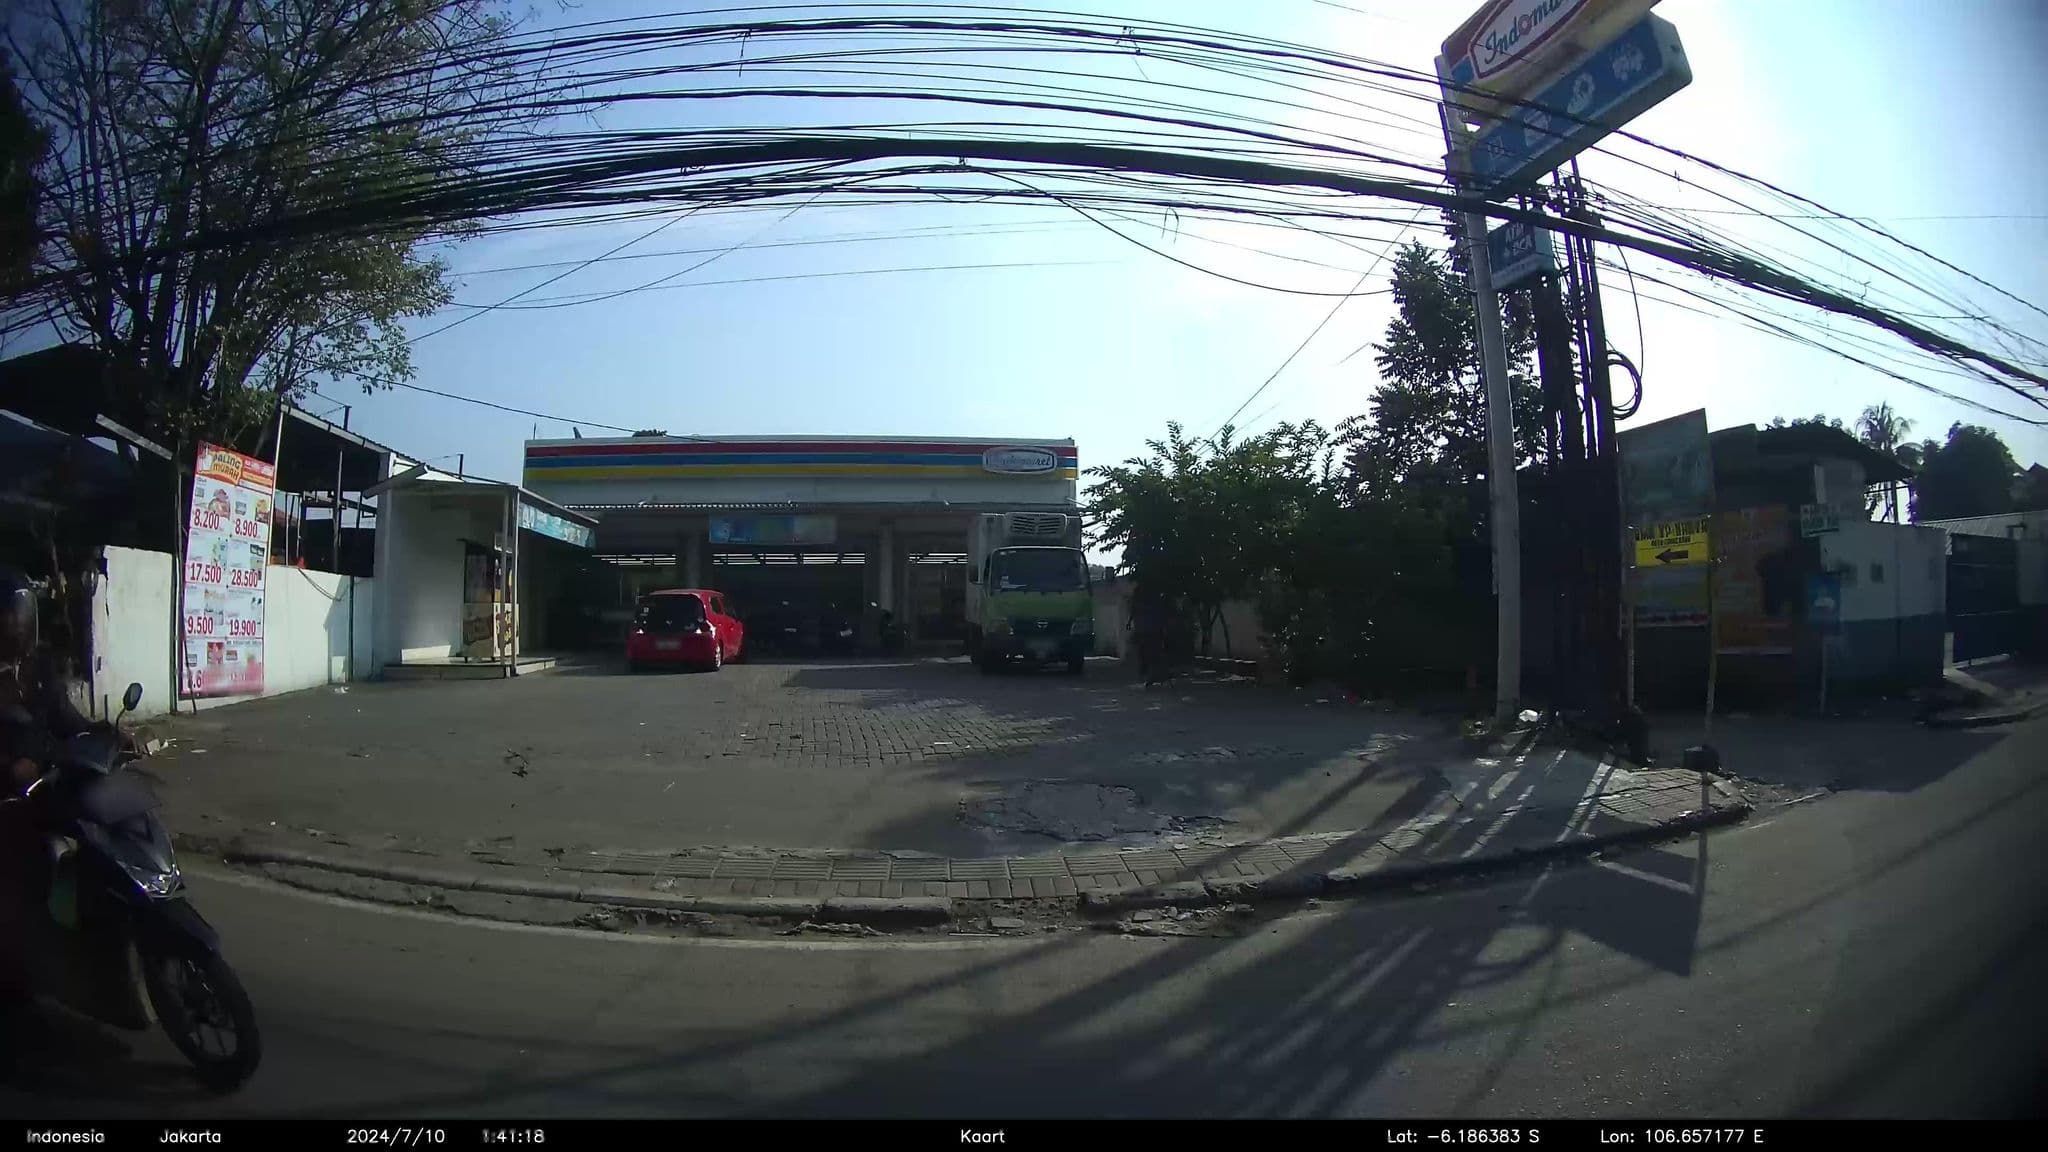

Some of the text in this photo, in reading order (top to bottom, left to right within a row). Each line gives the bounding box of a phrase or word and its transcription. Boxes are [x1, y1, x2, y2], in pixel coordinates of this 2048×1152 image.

[213, 462, 240, 480] MURAH
[193, 509, 220, 531] 8.200
[234, 518, 258, 538] 8.900
[190, 562, 222, 584] 17.500
[231, 568, 258, 588] 28.500
[187, 615, 214, 635] 9.500
[229, 618, 257, 637] 19.900
